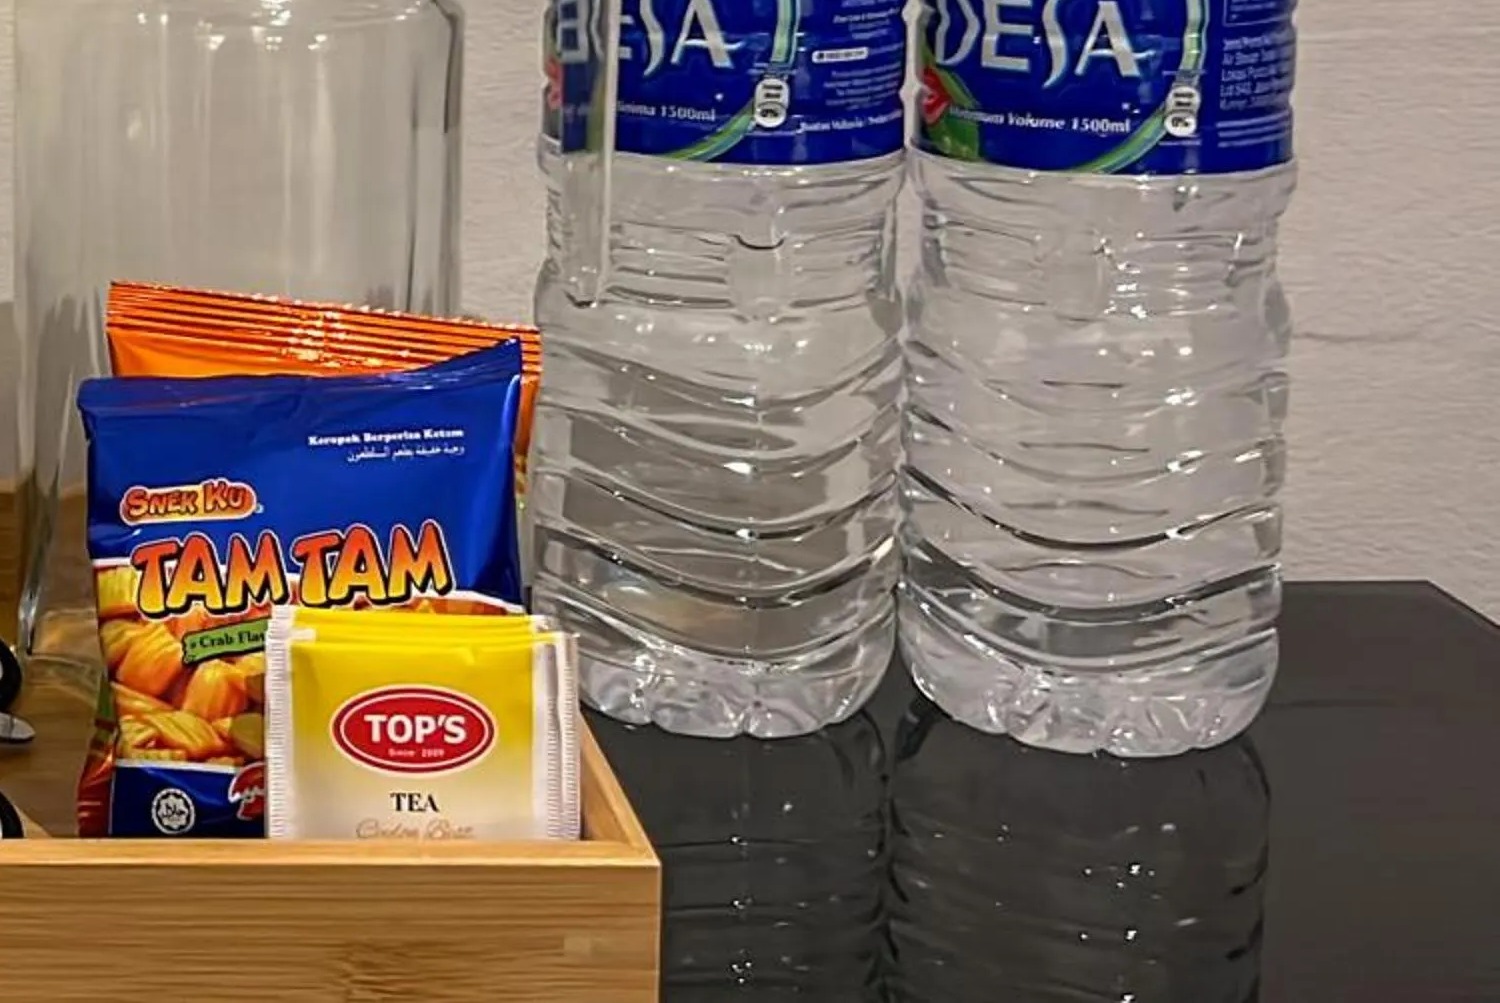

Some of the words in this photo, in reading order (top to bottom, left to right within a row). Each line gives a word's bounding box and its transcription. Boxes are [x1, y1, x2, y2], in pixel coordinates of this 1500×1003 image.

[661, 105, 716, 122] 1500ml
[1008, 112, 1064, 131] Volume
[1070, 117, 1131, 134] 1500ml
[132, 533, 285, 619] TAM
[290, 521, 455, 610] TAM
[199, 633, 234, 649] Crab
[363, 714, 467, 744] TOP'S
[389, 792, 440, 812] TEA
